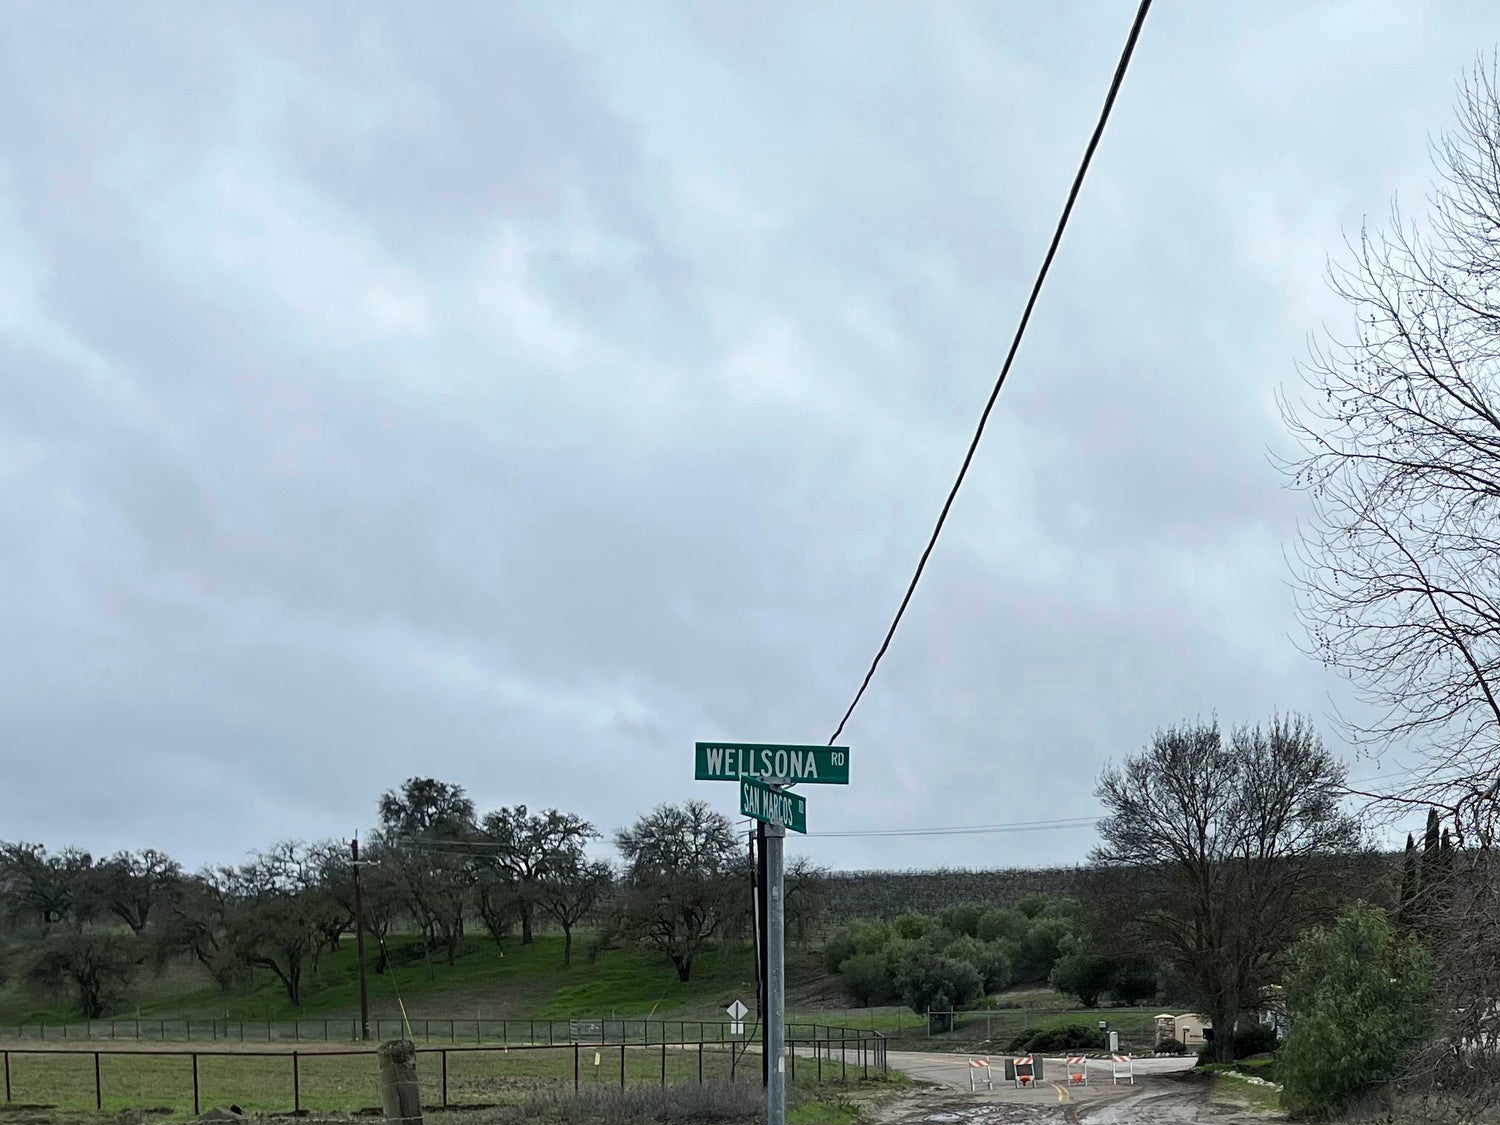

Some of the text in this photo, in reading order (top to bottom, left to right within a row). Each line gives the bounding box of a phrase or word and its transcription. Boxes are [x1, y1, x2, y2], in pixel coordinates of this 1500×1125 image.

[707, 748, 844, 778] WELLSONA RD
[744, 783, 804, 826] SAN MARCOS RD
